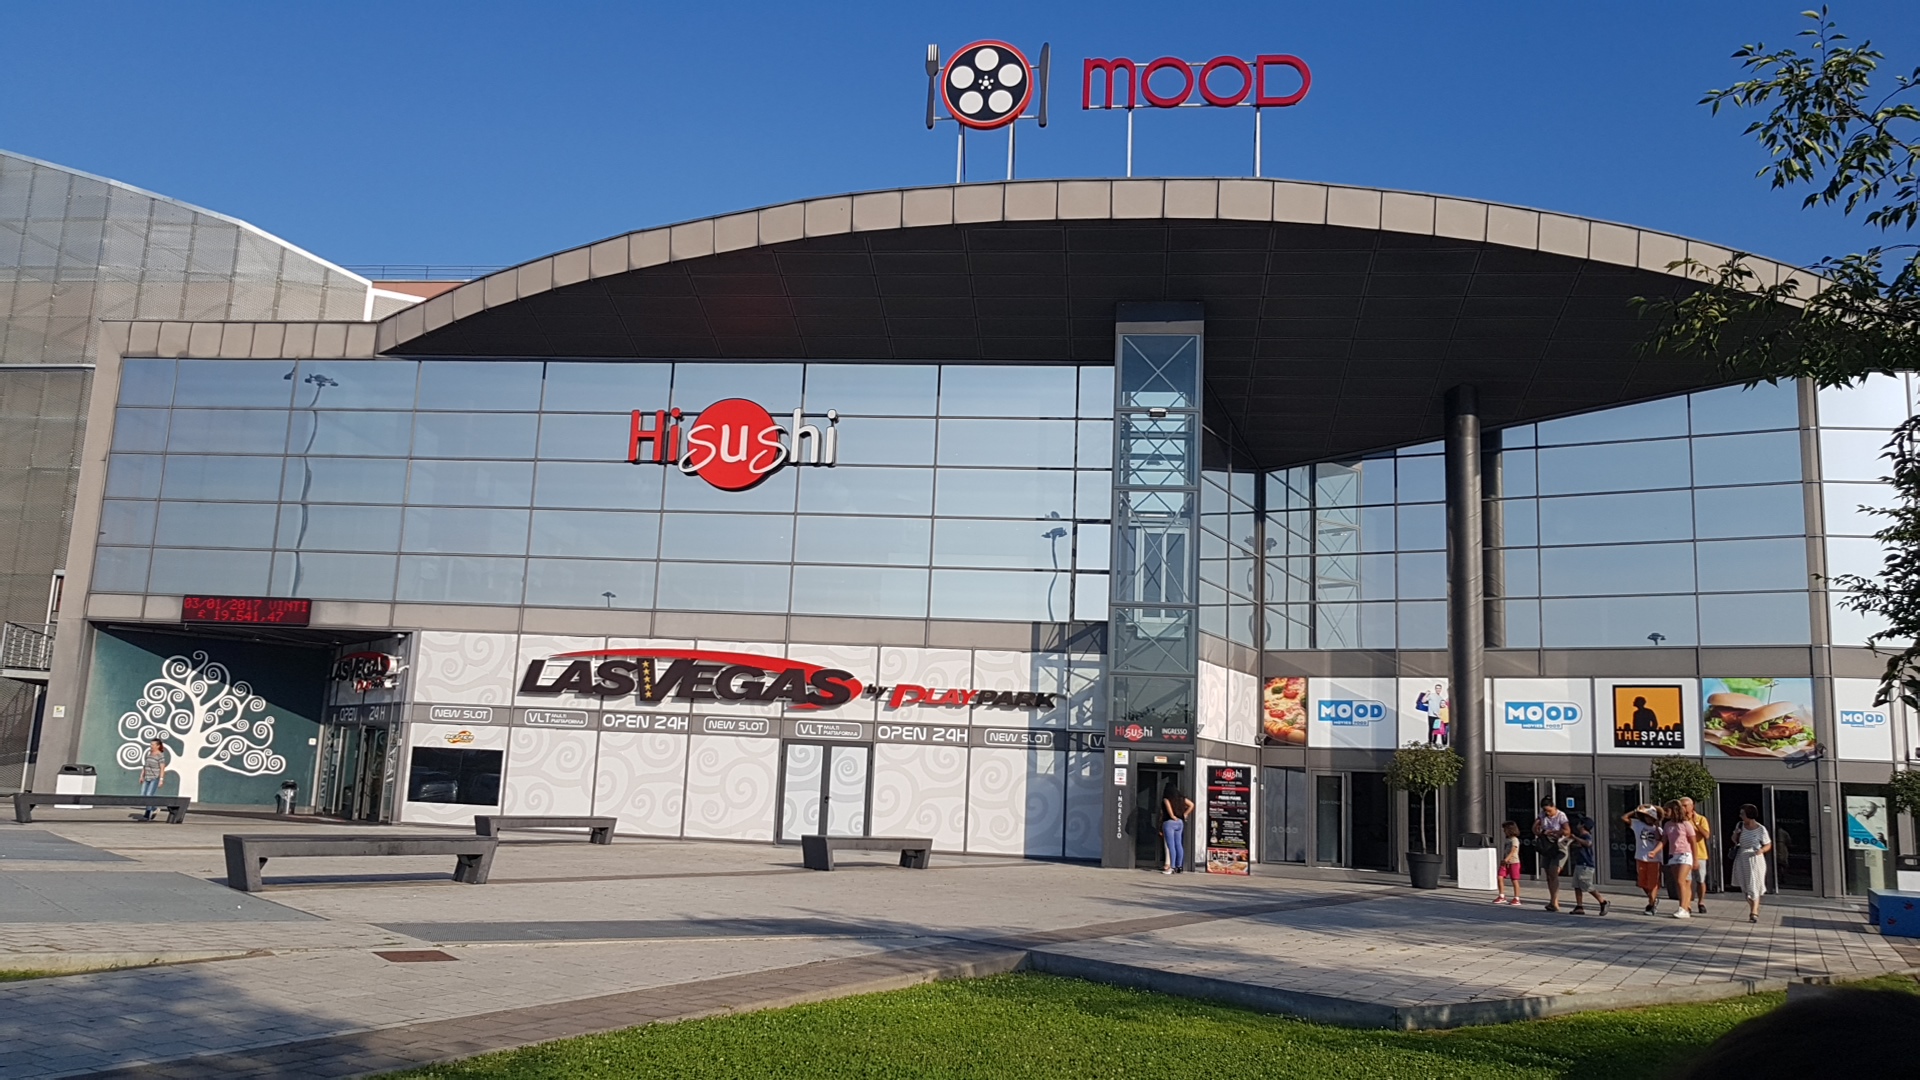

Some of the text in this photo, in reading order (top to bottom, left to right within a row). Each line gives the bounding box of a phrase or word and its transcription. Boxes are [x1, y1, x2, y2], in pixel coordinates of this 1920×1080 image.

[434, 709, 488, 719] NEW SLOT
[1320, 703, 1383, 718] MOOD
[1507, 705, 1578, 721] MOOD
[529, 712, 551, 723] VLT
[602, 713, 689, 730] OPEN 24H
[1842, 713, 1884, 723] MOOD
[708, 720, 765, 732] NEW SLOT
[799, 724, 823, 735] VLT
[1161, 727, 1188, 735] INGRESSO
[877, 725, 969, 743] OPEN 24H
[989, 732, 1048, 744] NEW SLOT
